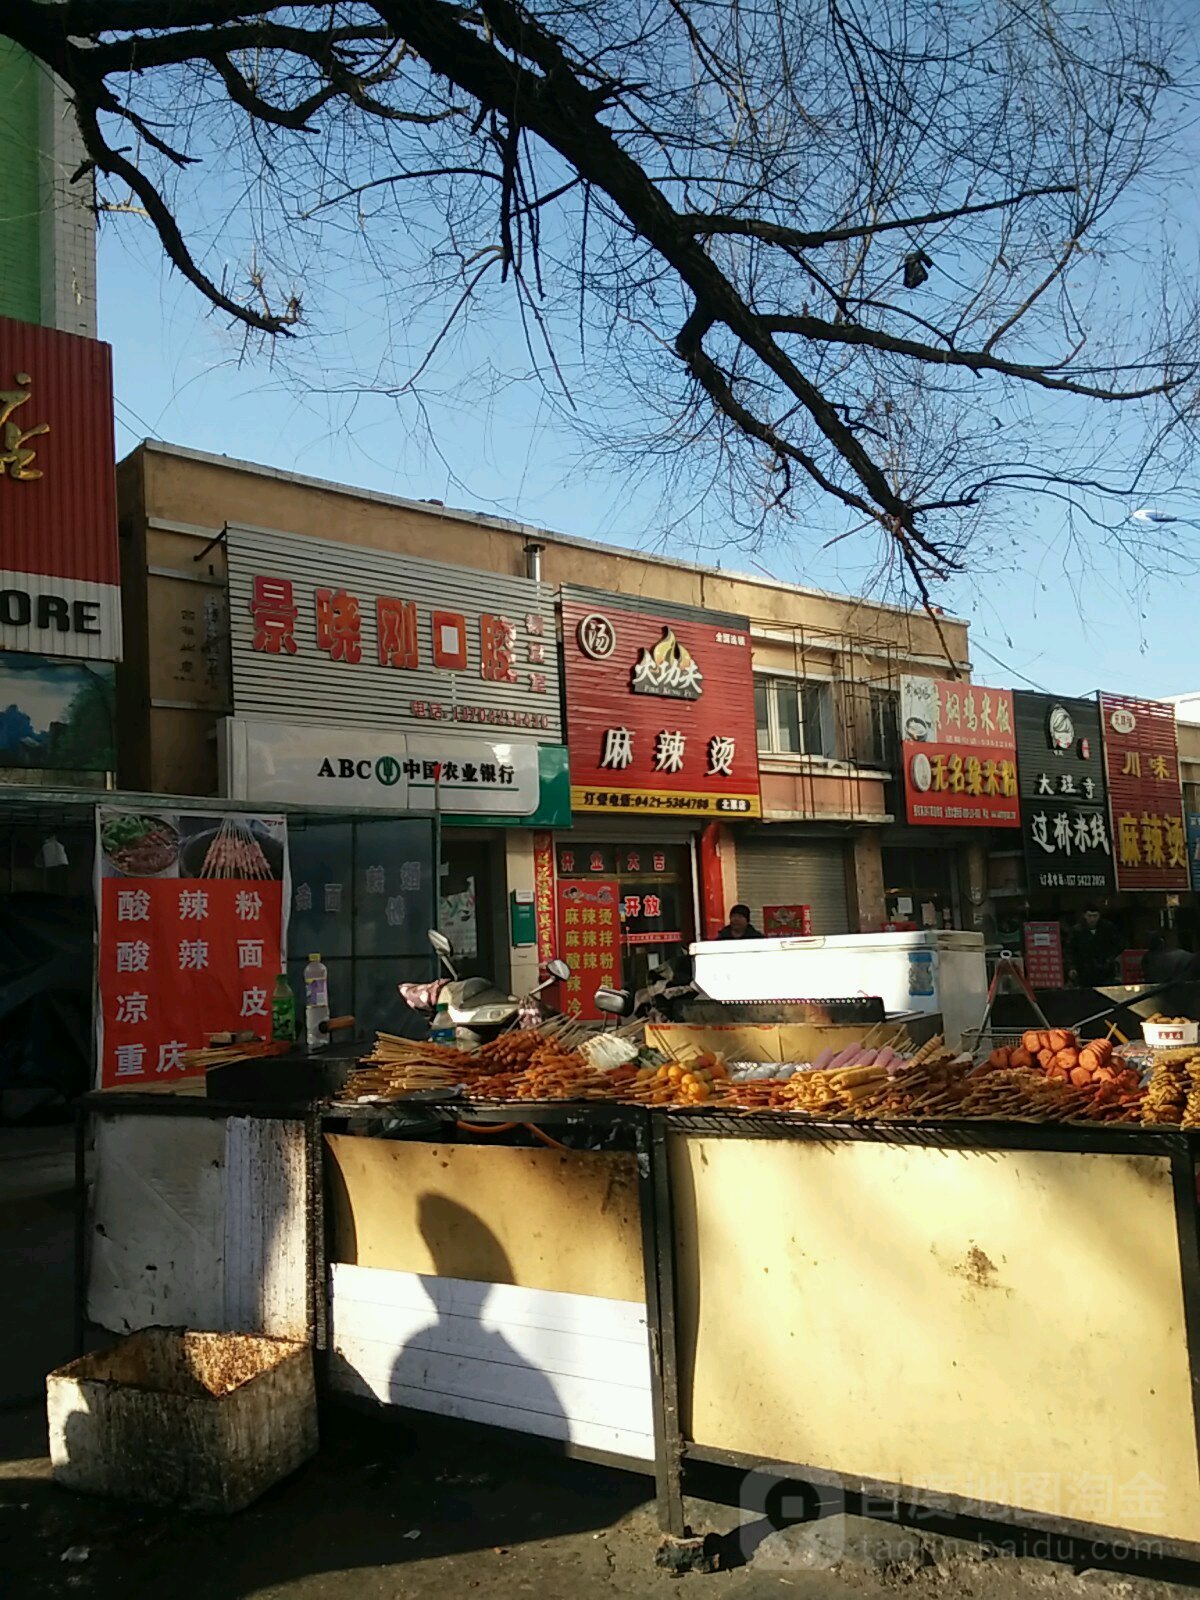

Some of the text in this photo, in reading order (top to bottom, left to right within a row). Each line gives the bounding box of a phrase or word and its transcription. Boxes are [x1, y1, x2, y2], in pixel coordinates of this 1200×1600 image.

[632, 658, 703, 694] 火功夫
[601, 726, 735, 776] 麻辣烫
[1122, 751, 1170, 780] 川味
[317, 758, 372, 779] ABC
[403, 759, 515, 785] 中国农业银行
[1032, 810, 1110, 856] 过桥米线
[1118, 812, 1186, 868] 麻辣烫
[561, 852, 665, 871] 开业大吉
[117, 889, 263, 922] 酸辣粉
[564, 908, 613, 926] 麻辣烫
[624, 895, 661, 917] 开放
[565, 930, 613, 947] 麻辣拌
[116, 939, 264, 973] 酸辣面
[565, 952, 614, 969] 酸辣粉
[115, 986, 269, 1024] 凉皮
